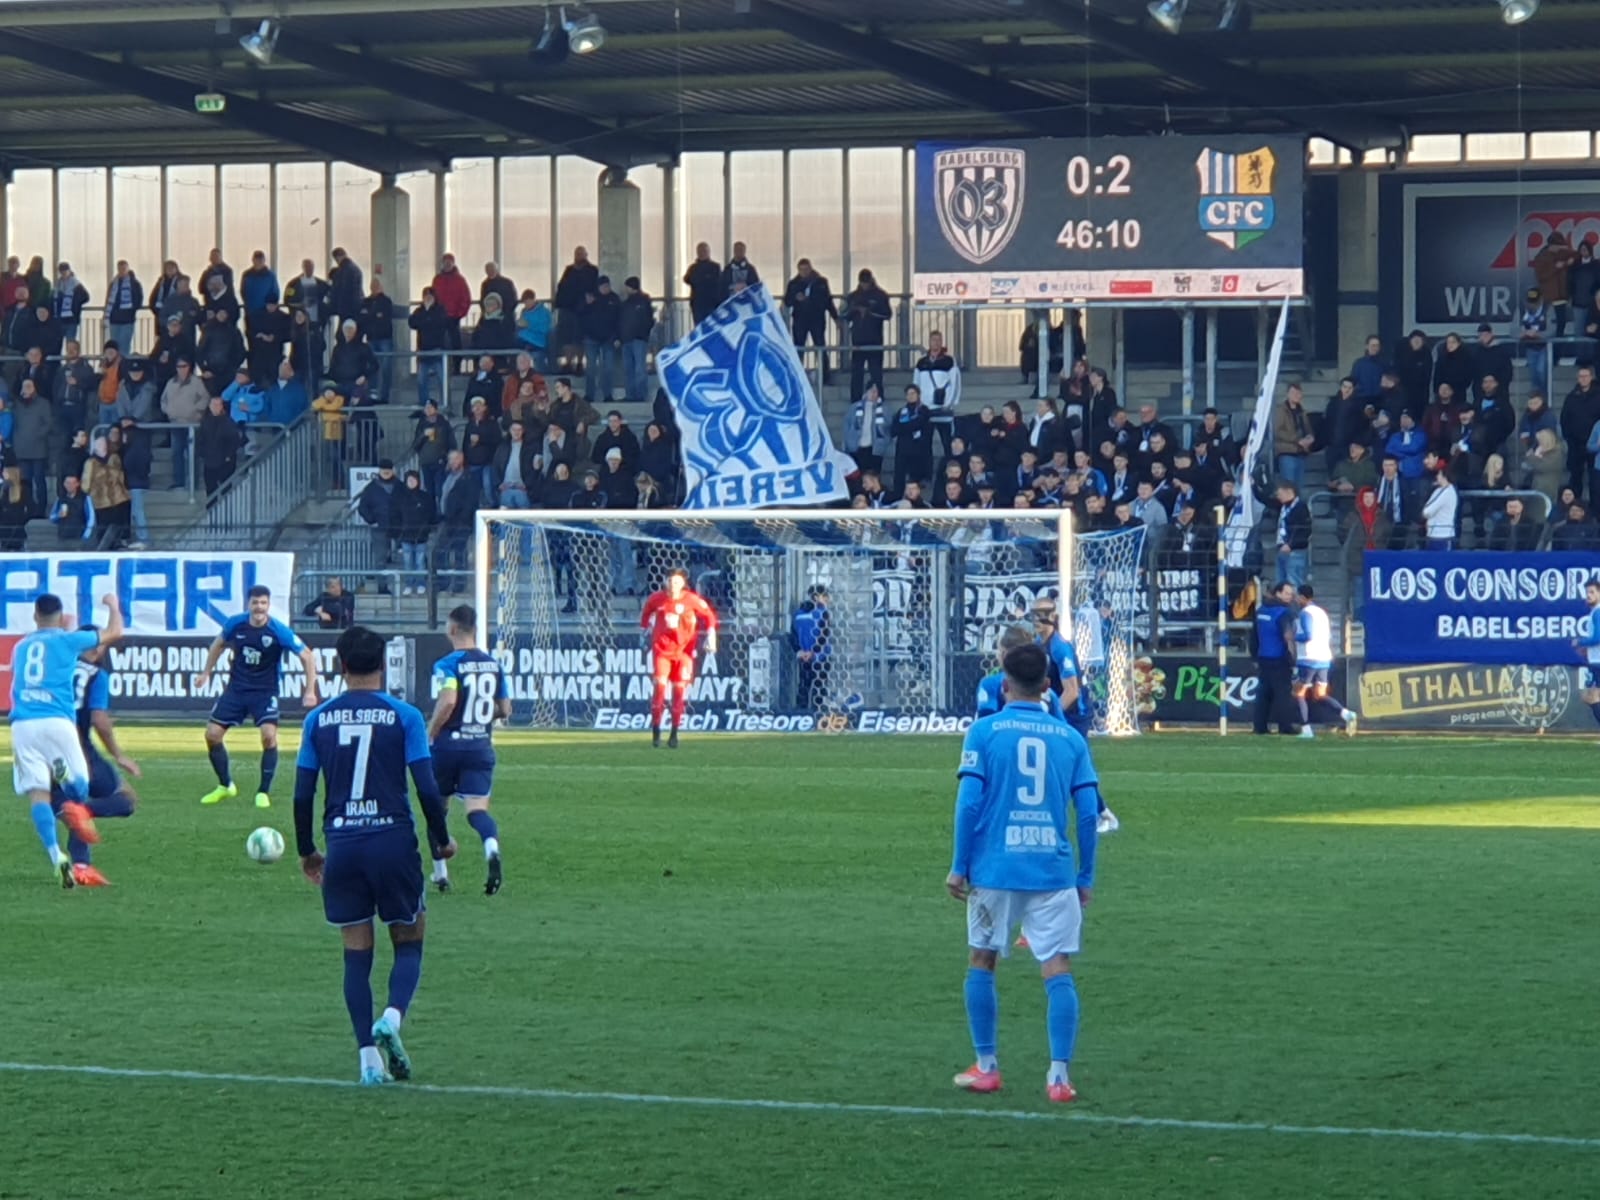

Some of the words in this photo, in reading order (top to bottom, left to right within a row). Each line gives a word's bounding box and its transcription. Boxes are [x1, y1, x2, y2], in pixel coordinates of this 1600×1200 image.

[1066, 154, 1131, 195] 0:2
[1207, 202, 1264, 225] CFC
[1057, 219, 1141, 250] 46:10
[928, 282, 953, 295] EWP
[1444, 286, 1512, 317] WIR
[356, 471, 380, 481] BLO
[1370, 566, 1437, 601] LOS
[1444, 567, 1600, 601] CONSOR
[24, 641, 45, 687] 8
[109, 646, 162, 671] WHO
[519, 649, 599, 674] DRINKS
[605, 649, 654, 674] MIL
[108, 672, 187, 697] OTBALL
[551, 676, 621, 701] MATCH
[1367, 681, 1393, 698] 100
[1406, 667, 1513, 702] THALIA
[463, 673, 497, 725] 18
[318, 708, 396, 728] BABELSBERG
[725, 709, 814, 731] Tresore
[858, 711, 978, 732] Eisenbac
[339, 724, 373, 800] 7
[1016, 736, 1047, 806] 9
[345, 799, 378, 817] IRAQI
